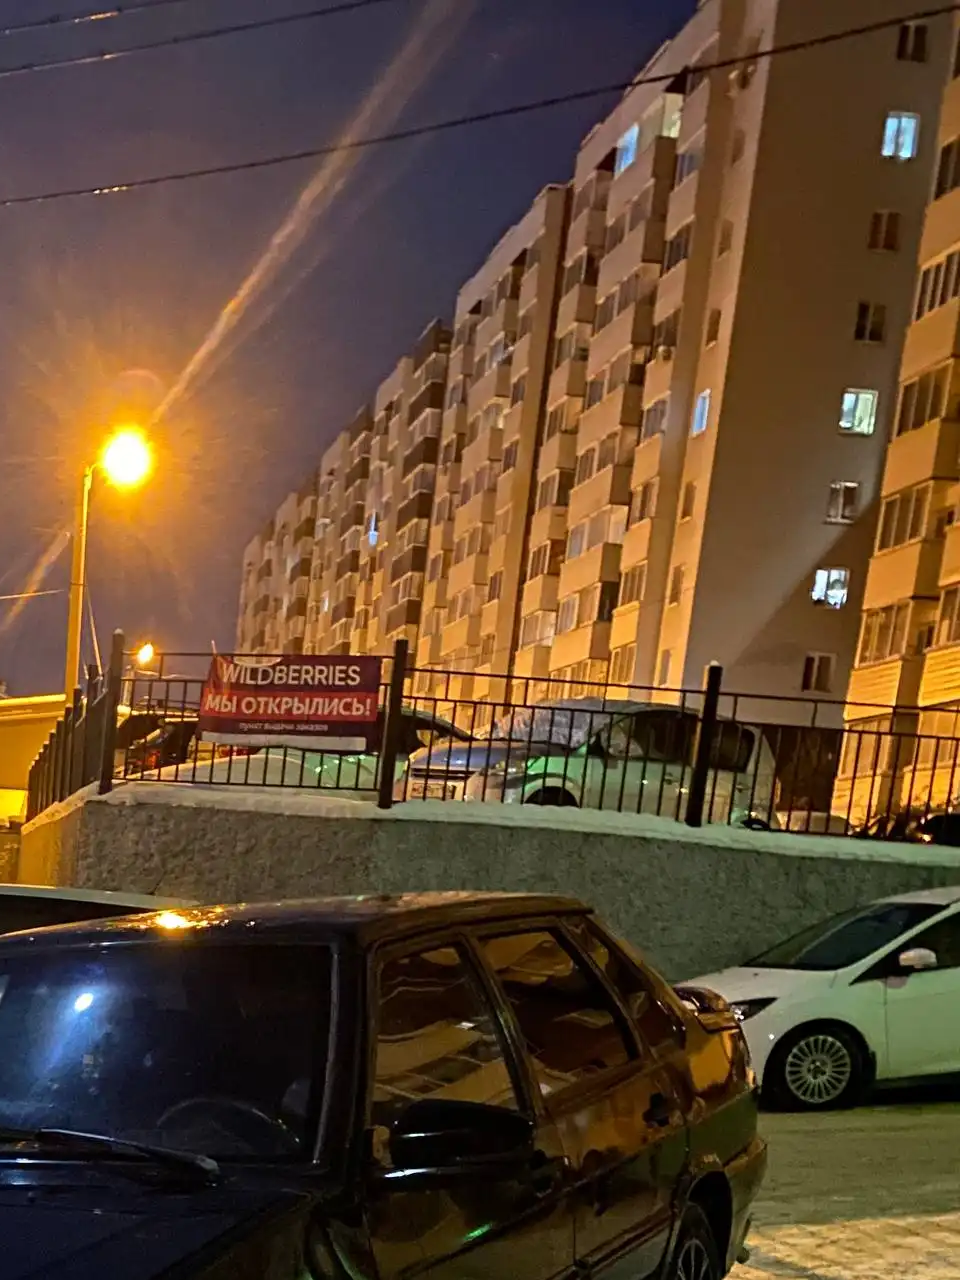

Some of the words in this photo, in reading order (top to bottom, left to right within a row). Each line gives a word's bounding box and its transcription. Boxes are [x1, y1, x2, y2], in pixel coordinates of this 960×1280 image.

[222, 664, 361, 686] WILDBERRIES
[205, 693, 237, 714] МЫ
[241, 696, 371, 716] ОТКРЫЛИСЬ!
